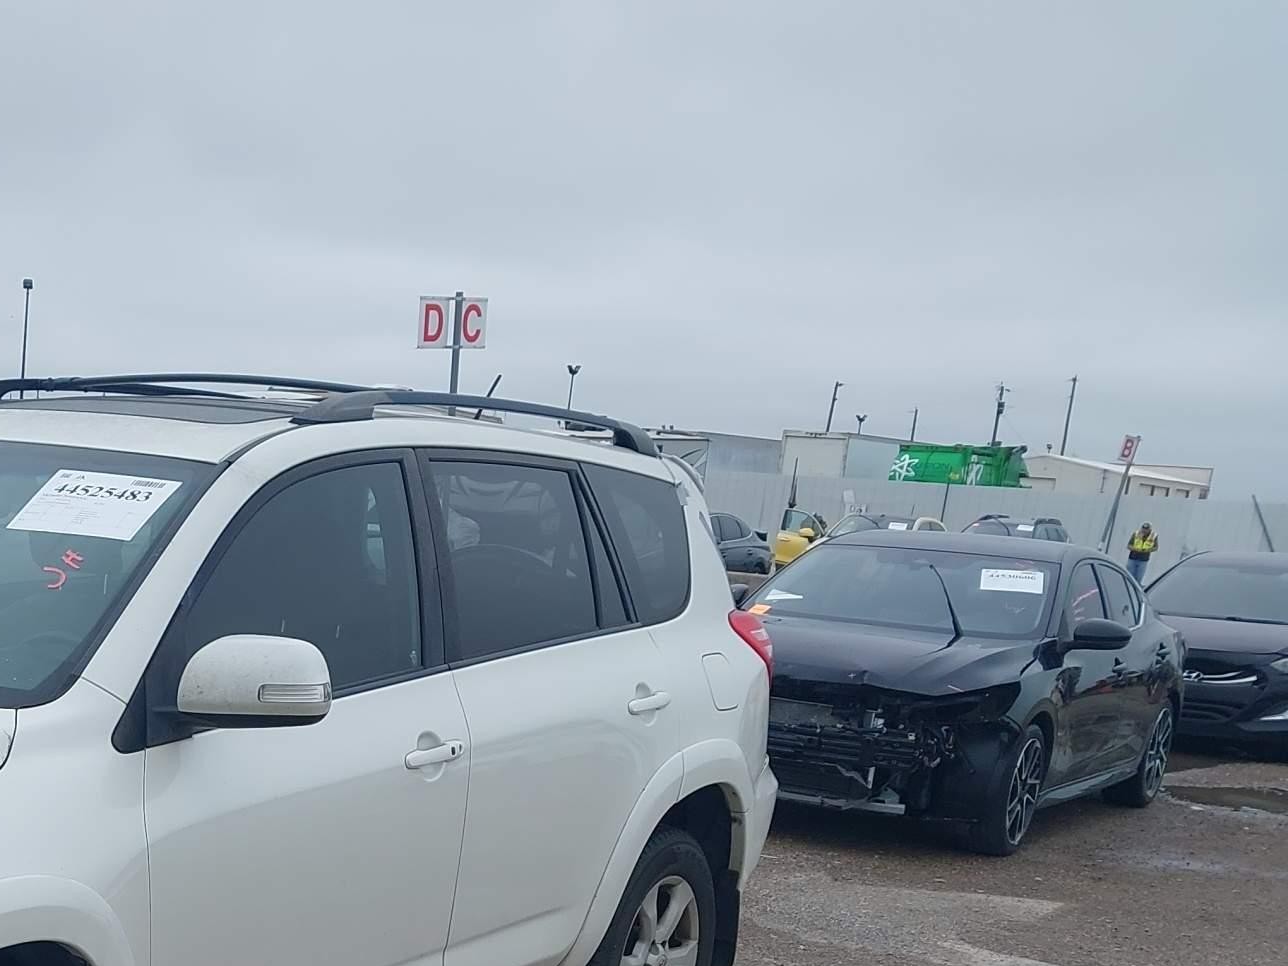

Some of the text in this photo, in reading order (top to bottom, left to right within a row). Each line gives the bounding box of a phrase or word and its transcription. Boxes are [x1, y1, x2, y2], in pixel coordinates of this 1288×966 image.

[423, 303, 444, 342] D
[462, 303, 482, 343] C
[1121, 438, 1134, 458] B
[54, 482, 153, 503] 44525483
